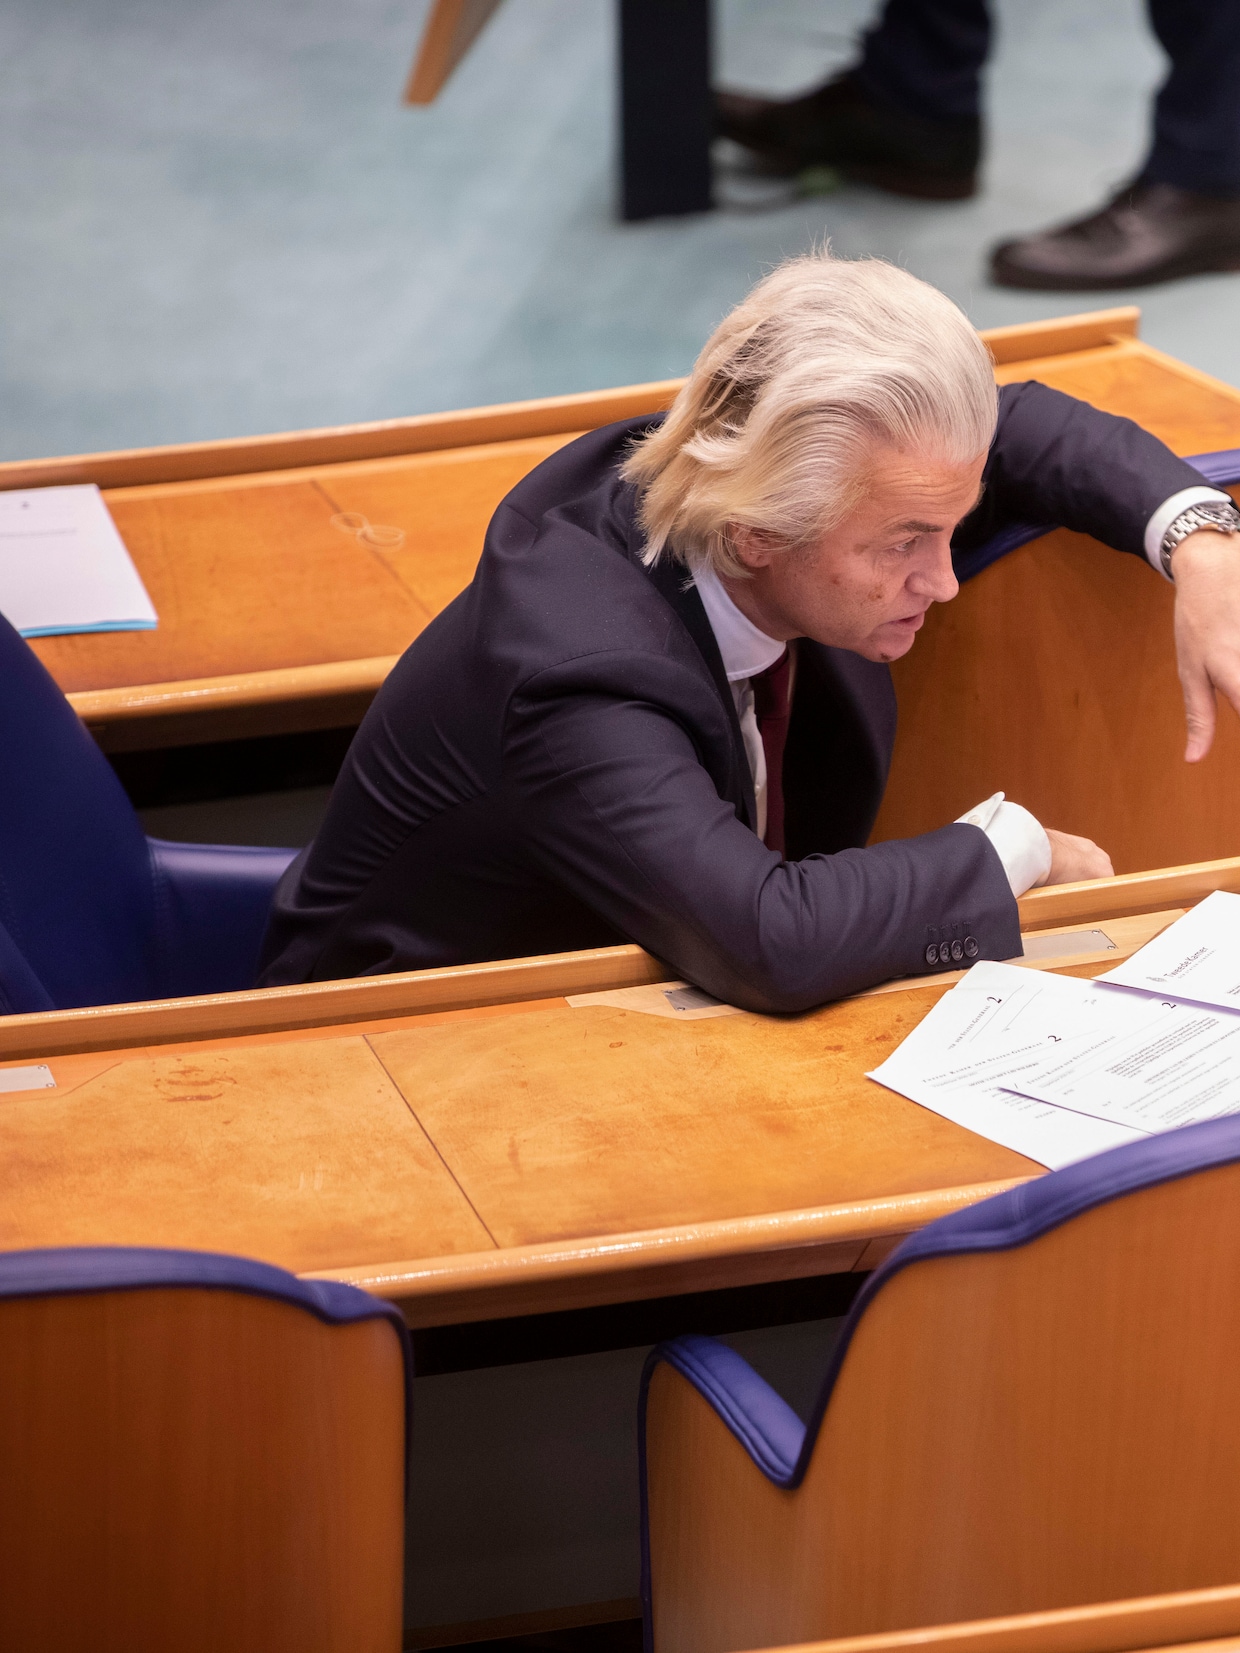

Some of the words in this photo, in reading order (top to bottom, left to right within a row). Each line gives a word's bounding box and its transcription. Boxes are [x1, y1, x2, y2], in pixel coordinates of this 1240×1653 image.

[1163, 959, 1192, 977] Tweede
[1186, 946, 1208, 962] Kamer
[986, 996, 1002, 1004] 2
